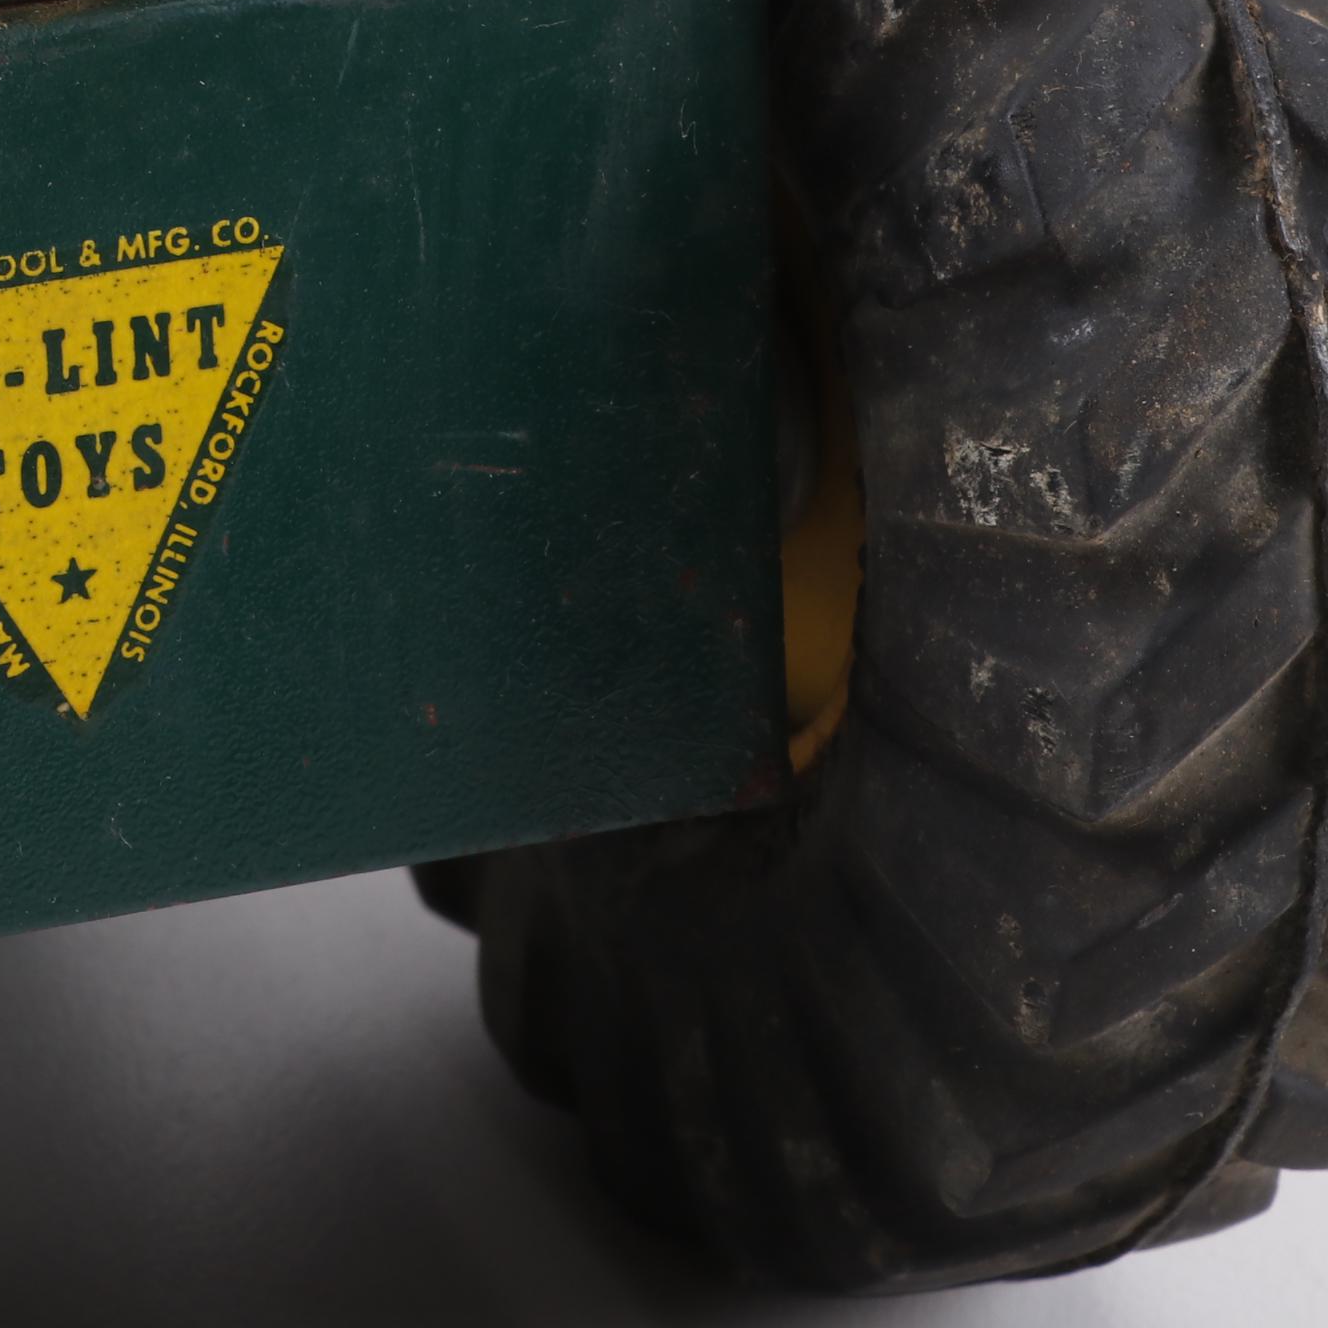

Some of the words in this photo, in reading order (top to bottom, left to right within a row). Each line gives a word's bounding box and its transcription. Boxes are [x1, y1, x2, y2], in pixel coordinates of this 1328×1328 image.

[79, 239, 102, 268] &
[117, 226, 200, 263] MFG.
[211, 216, 270, 248] CO.
[179, 320, 284, 510] ROCKFORD,
[121, 522, 198, 663] ILLINOIS
